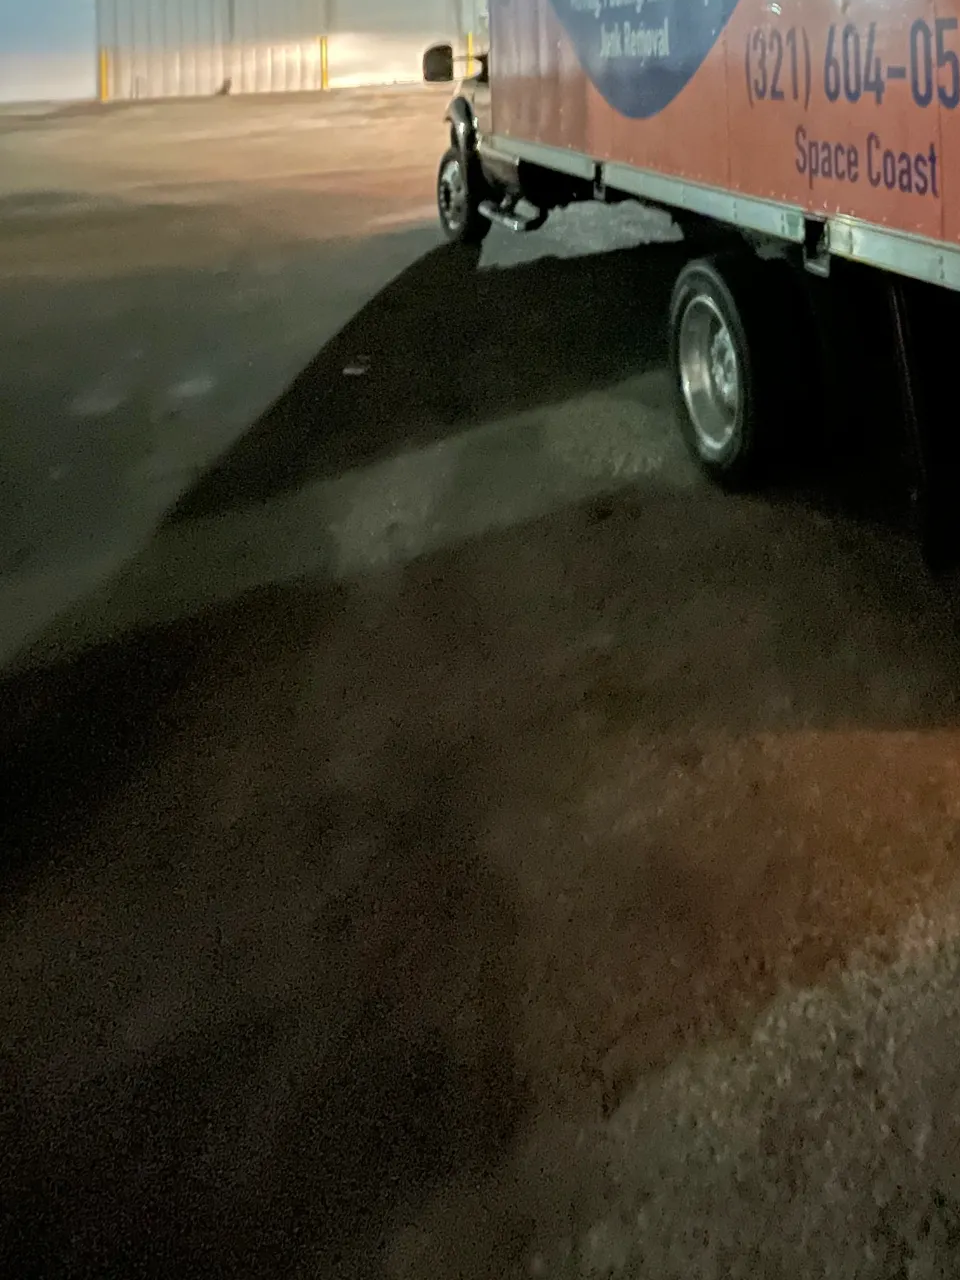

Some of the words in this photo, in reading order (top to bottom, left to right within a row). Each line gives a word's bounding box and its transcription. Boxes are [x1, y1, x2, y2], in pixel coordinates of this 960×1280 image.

[744, 25, 812, 112] (321)
[795, 124, 859, 191] Space
[866, 132, 940, 199] Coast
